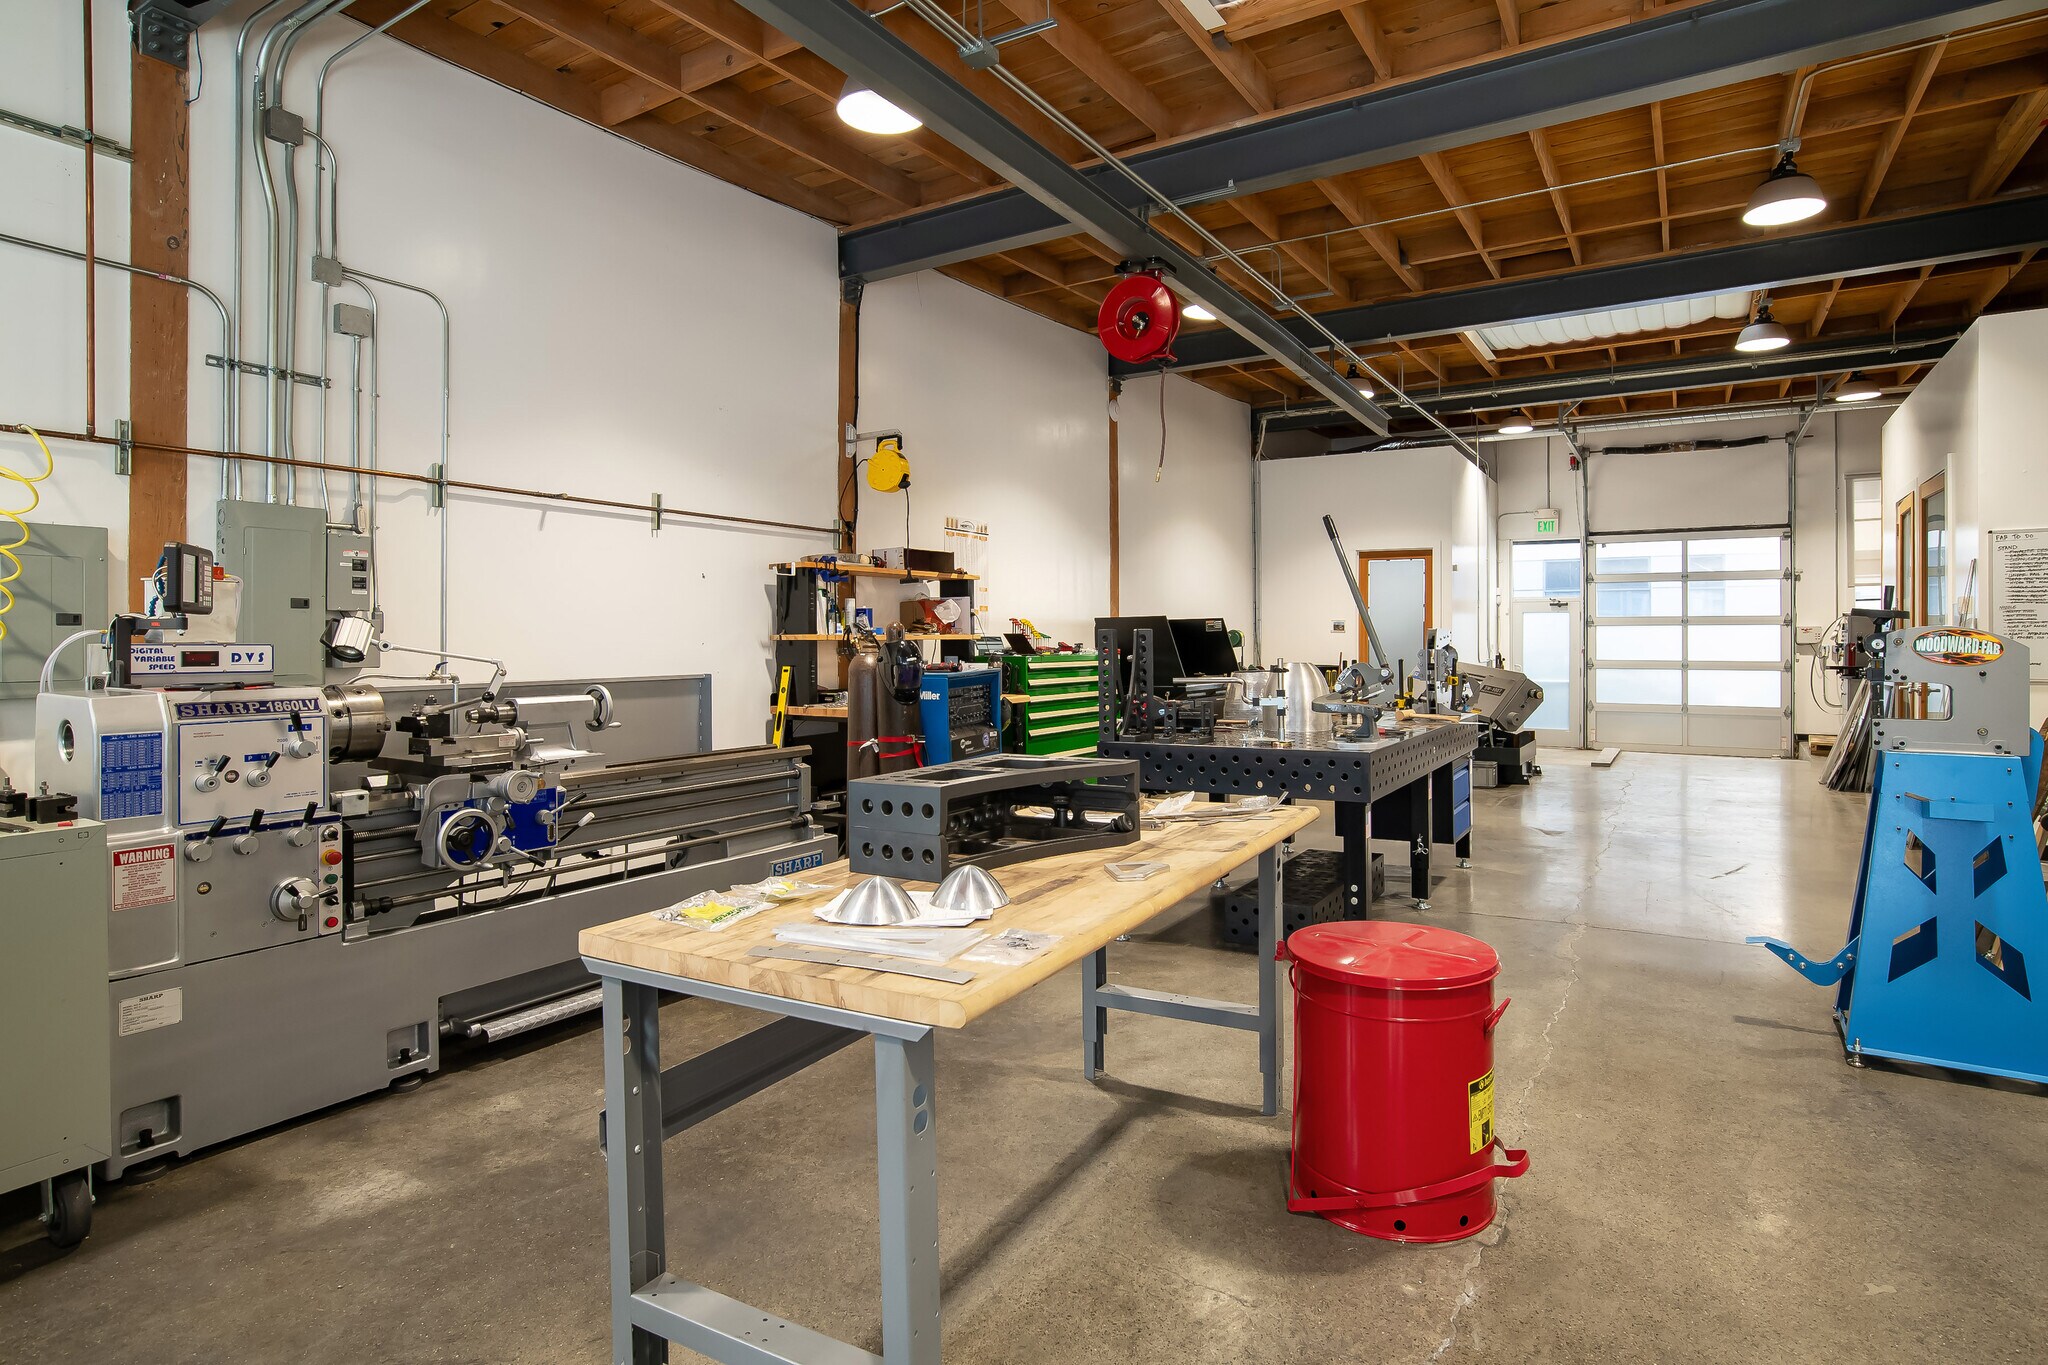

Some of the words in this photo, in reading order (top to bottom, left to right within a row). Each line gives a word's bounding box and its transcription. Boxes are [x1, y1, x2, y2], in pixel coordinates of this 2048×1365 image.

[1537, 520, 1555, 533] EXIT
[181, 700, 315, 717] SHARP-1860LV
[119, 848, 170, 865] WARNING
[775, 854, 821, 876] SHARP
[139, 993, 164, 1002] SHARP
